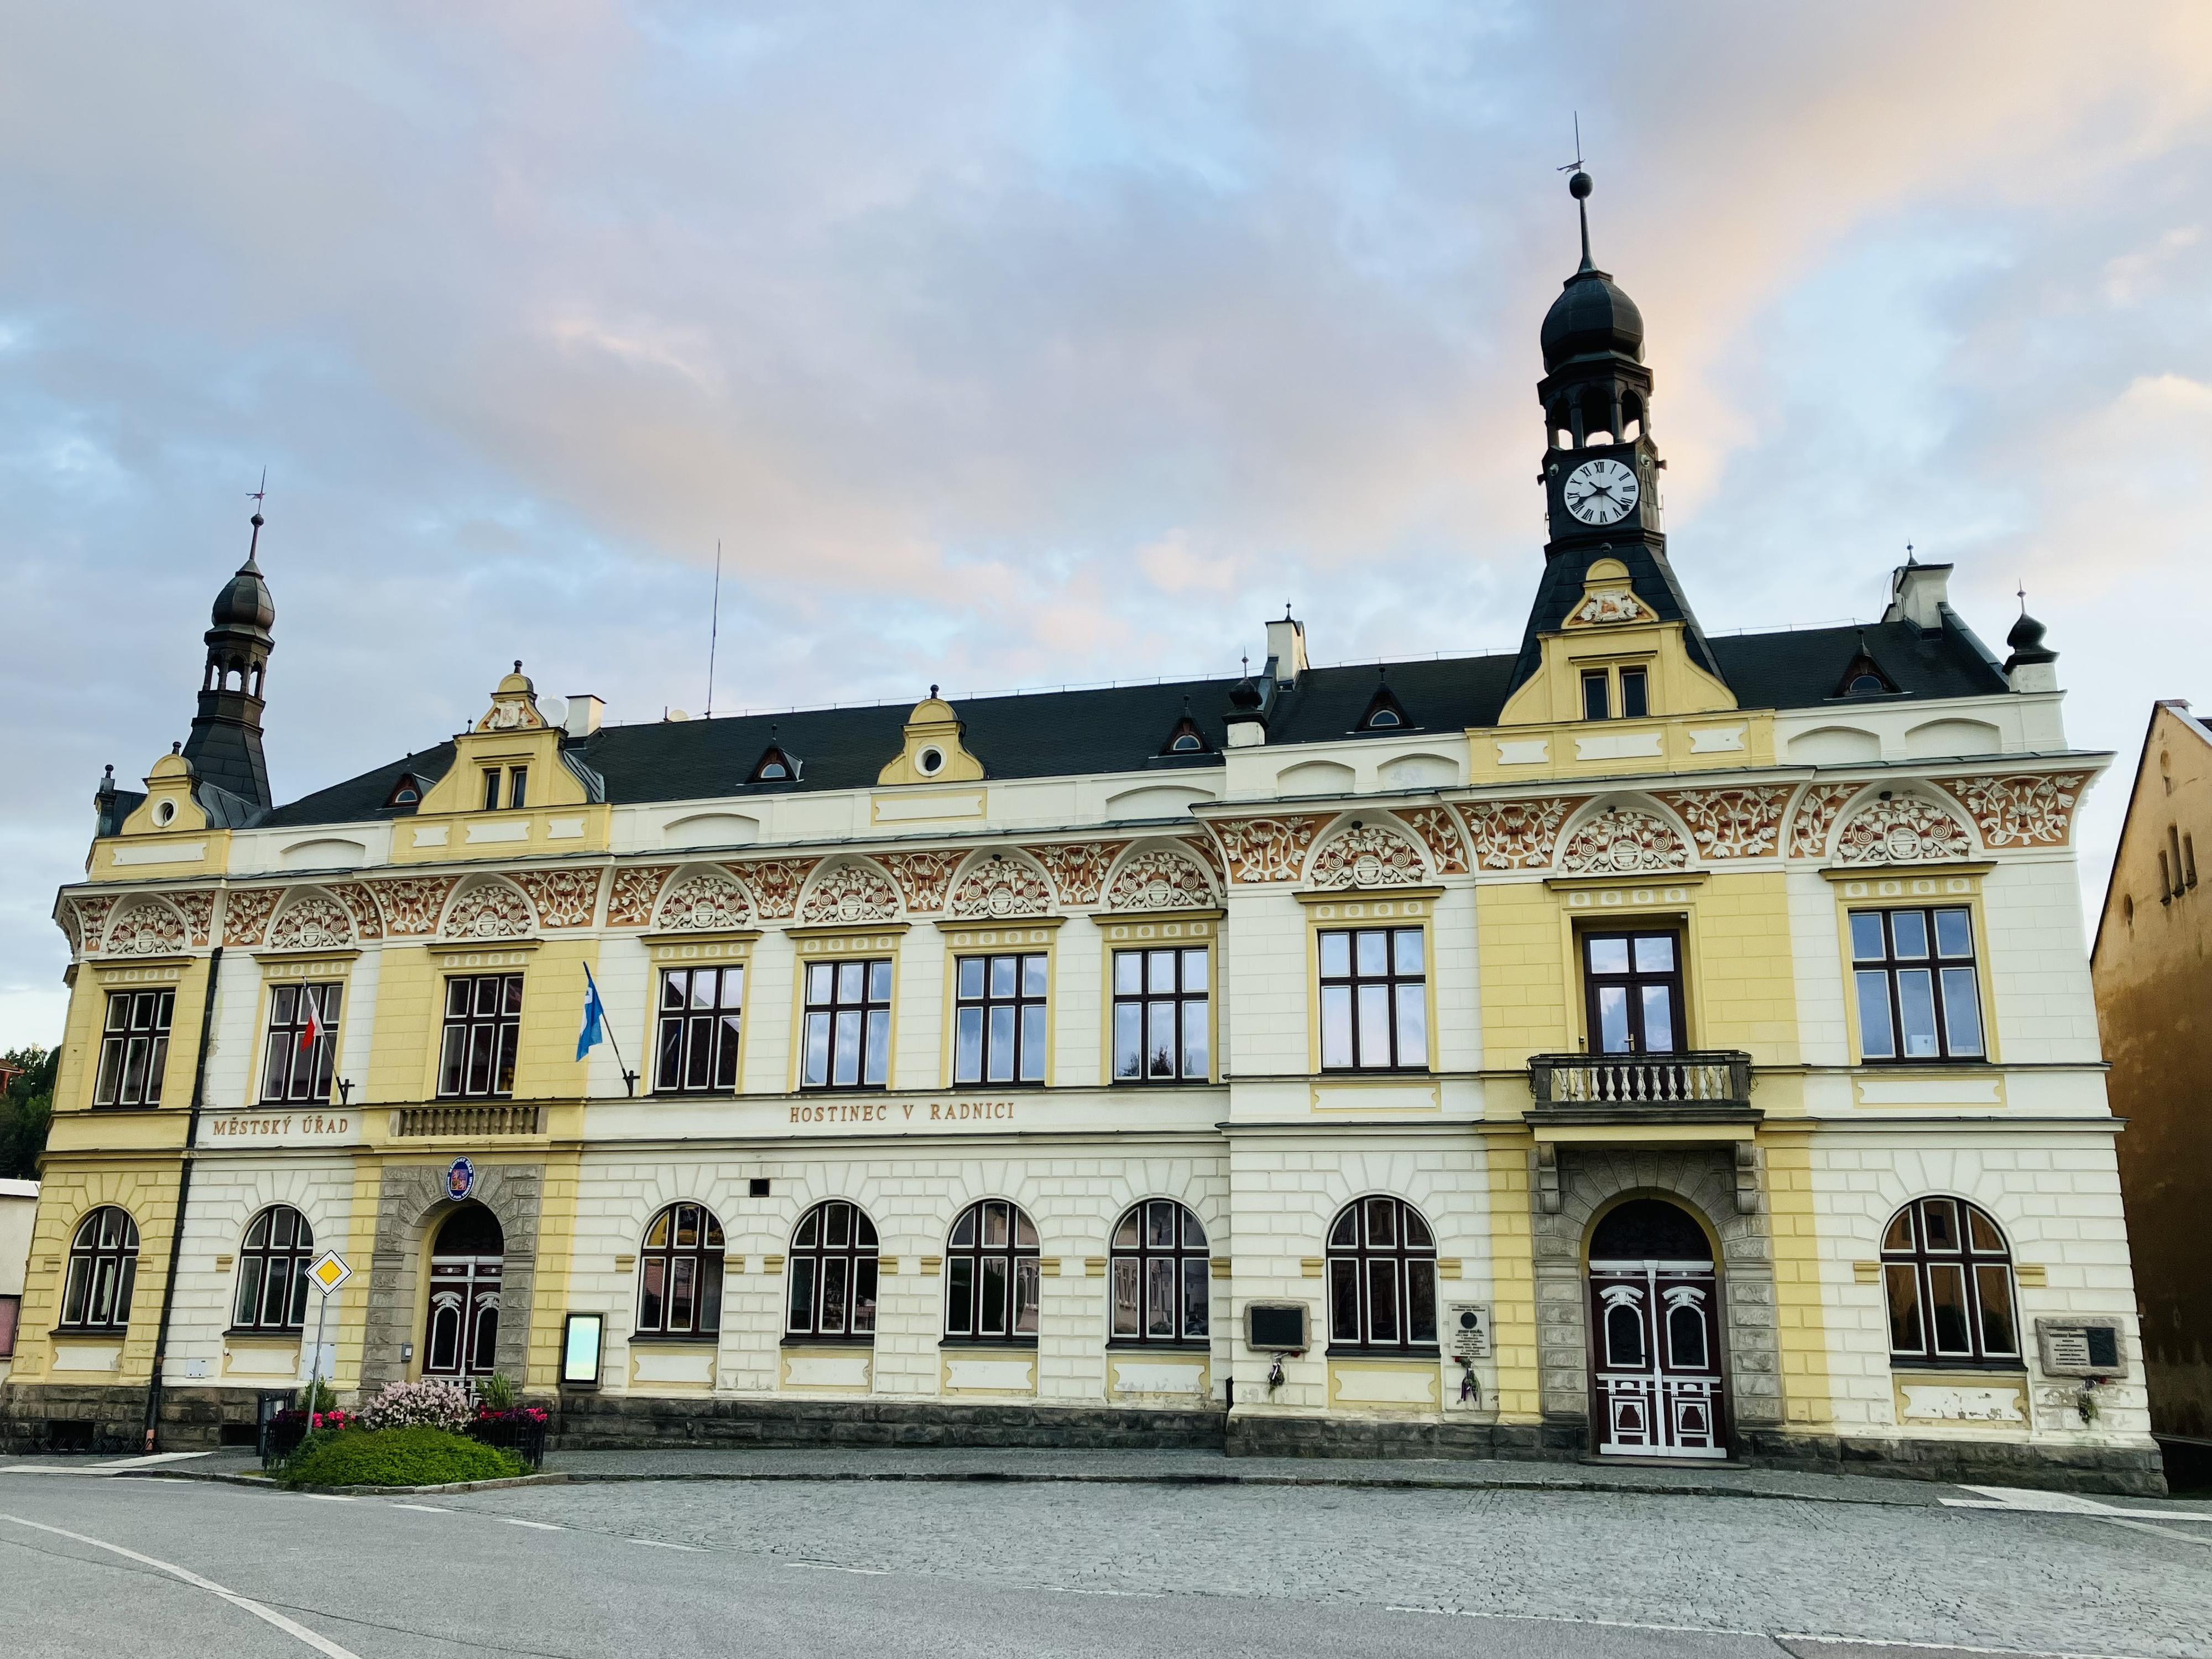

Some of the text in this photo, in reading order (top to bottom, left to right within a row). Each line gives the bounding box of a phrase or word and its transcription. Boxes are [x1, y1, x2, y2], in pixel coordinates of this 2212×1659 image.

[1579, 466, 1592, 478] XI
[1594, 461, 1605, 473] XII
[1610, 463, 1617, 474] I
[1618, 472, 1631, 481] II
[1581, 508, 1594, 521] VII
[790, 1103, 1014, 1123] HOSTINEC V RADNICI
[213, 1115, 348, 1135] MĚSTSKÝ ÚŘAD
